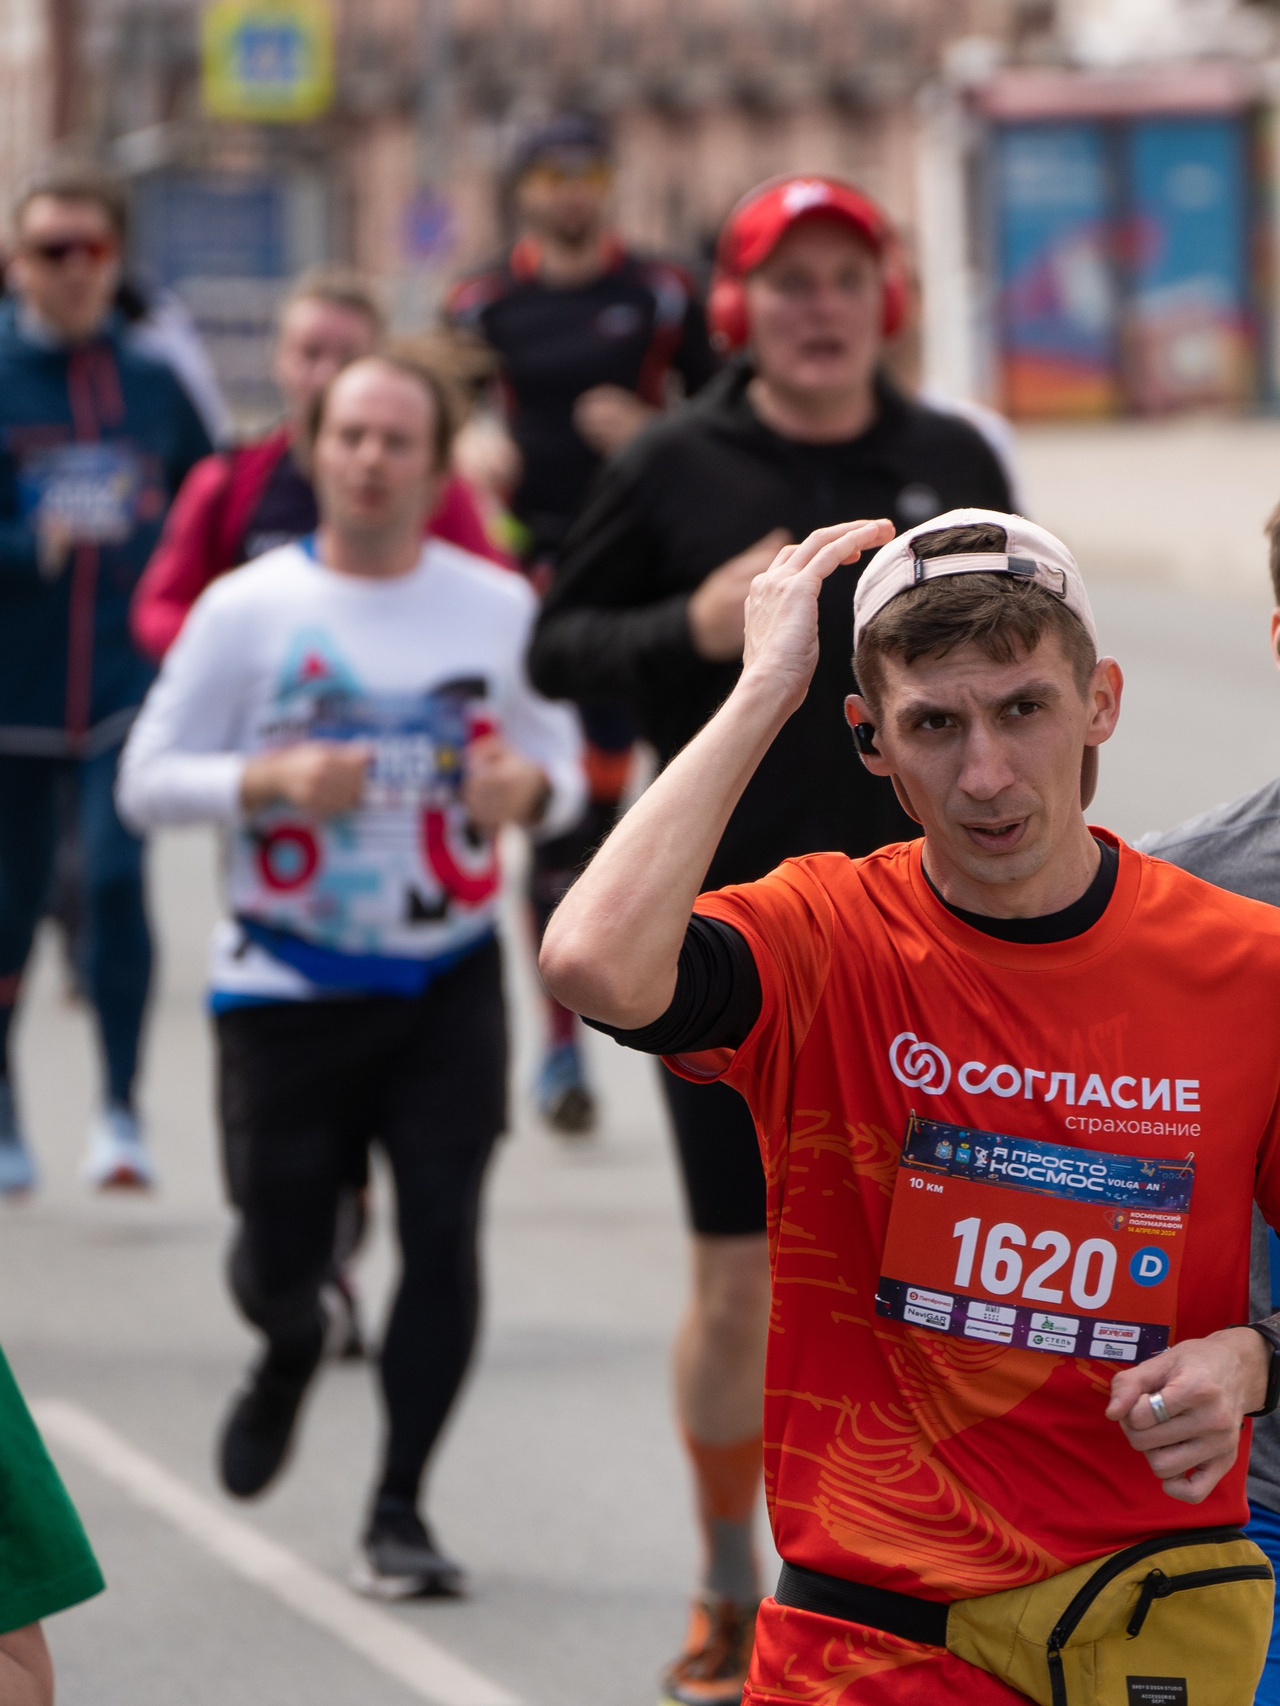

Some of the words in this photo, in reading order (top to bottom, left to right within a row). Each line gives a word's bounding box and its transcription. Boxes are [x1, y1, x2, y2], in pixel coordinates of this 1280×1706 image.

[958, 1061, 1201, 1112] СОГЛАСИЕ
[1065, 1114, 1201, 1137] страхование
[993, 1147, 1008, 1159] Я
[1012, 1150, 1107, 1176] ПРОСТО
[909, 1177, 924, 1189] 10
[990, 1160, 1105, 1192] КОСМОС
[952, 1217, 1118, 1310] 1620
[1139, 1255, 1163, 1277] D
[907, 1308, 947, 1323] NaviGAR
